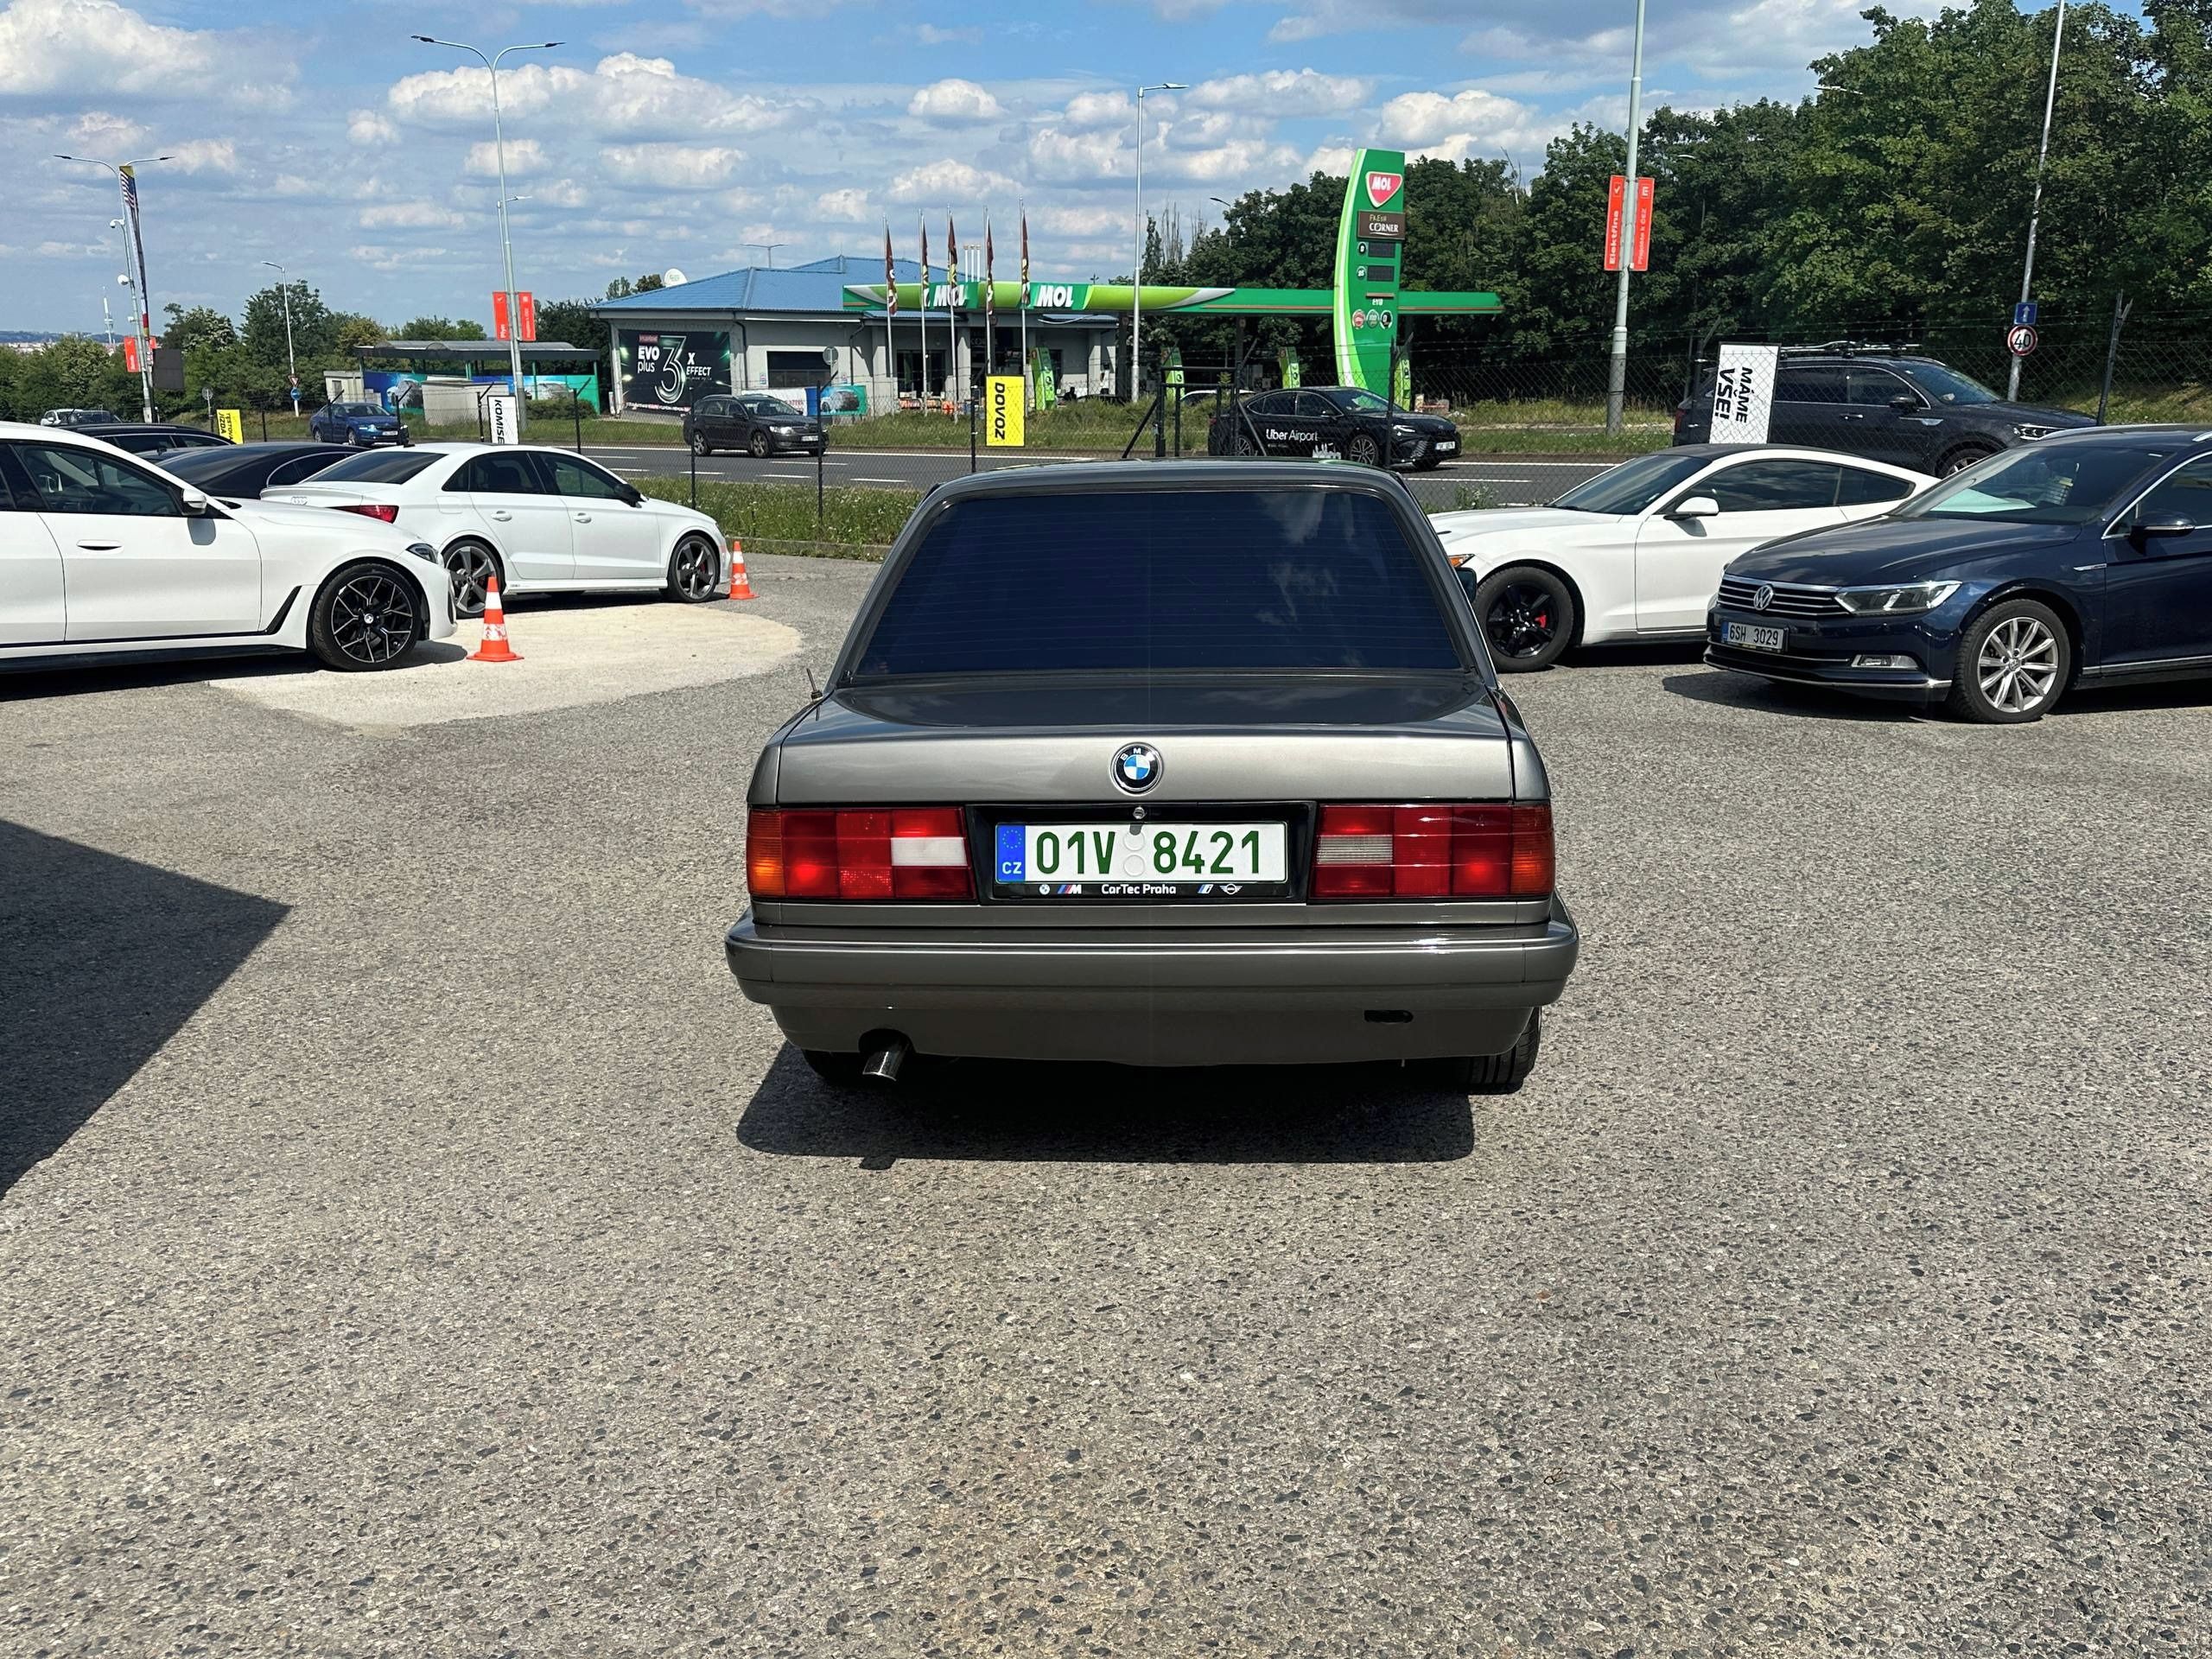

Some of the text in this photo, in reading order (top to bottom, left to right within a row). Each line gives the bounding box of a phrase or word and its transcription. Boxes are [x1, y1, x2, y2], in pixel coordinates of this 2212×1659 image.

[1372, 176, 1391, 190] MOL
[1369, 223, 1398, 232] CORNER
[1610, 211, 1619, 264] Elektřina
[1037, 285, 1073, 307] MOL
[2014, 334, 2031, 348] 40
[639, 346, 659, 360] EVO
[638, 359, 655, 373] plus
[655, 334, 686, 404] 3
[686, 366, 711, 376] EFFECT
[1715, 368, 1738, 420] VŠE!
[1735, 366, 1754, 423] MÁME
[995, 383, 1005, 440] DOVOZ
[494, 399, 505, 445] KOMISE
[1266, 429, 1318, 442] Uber Airport
[1730, 625, 1778, 645] 6SH 3029
[1037, 831, 1259, 874] 01V 8421
[1002, 861, 1021, 874] CZ
[1101, 884, 1176, 894] CarTec Praha
